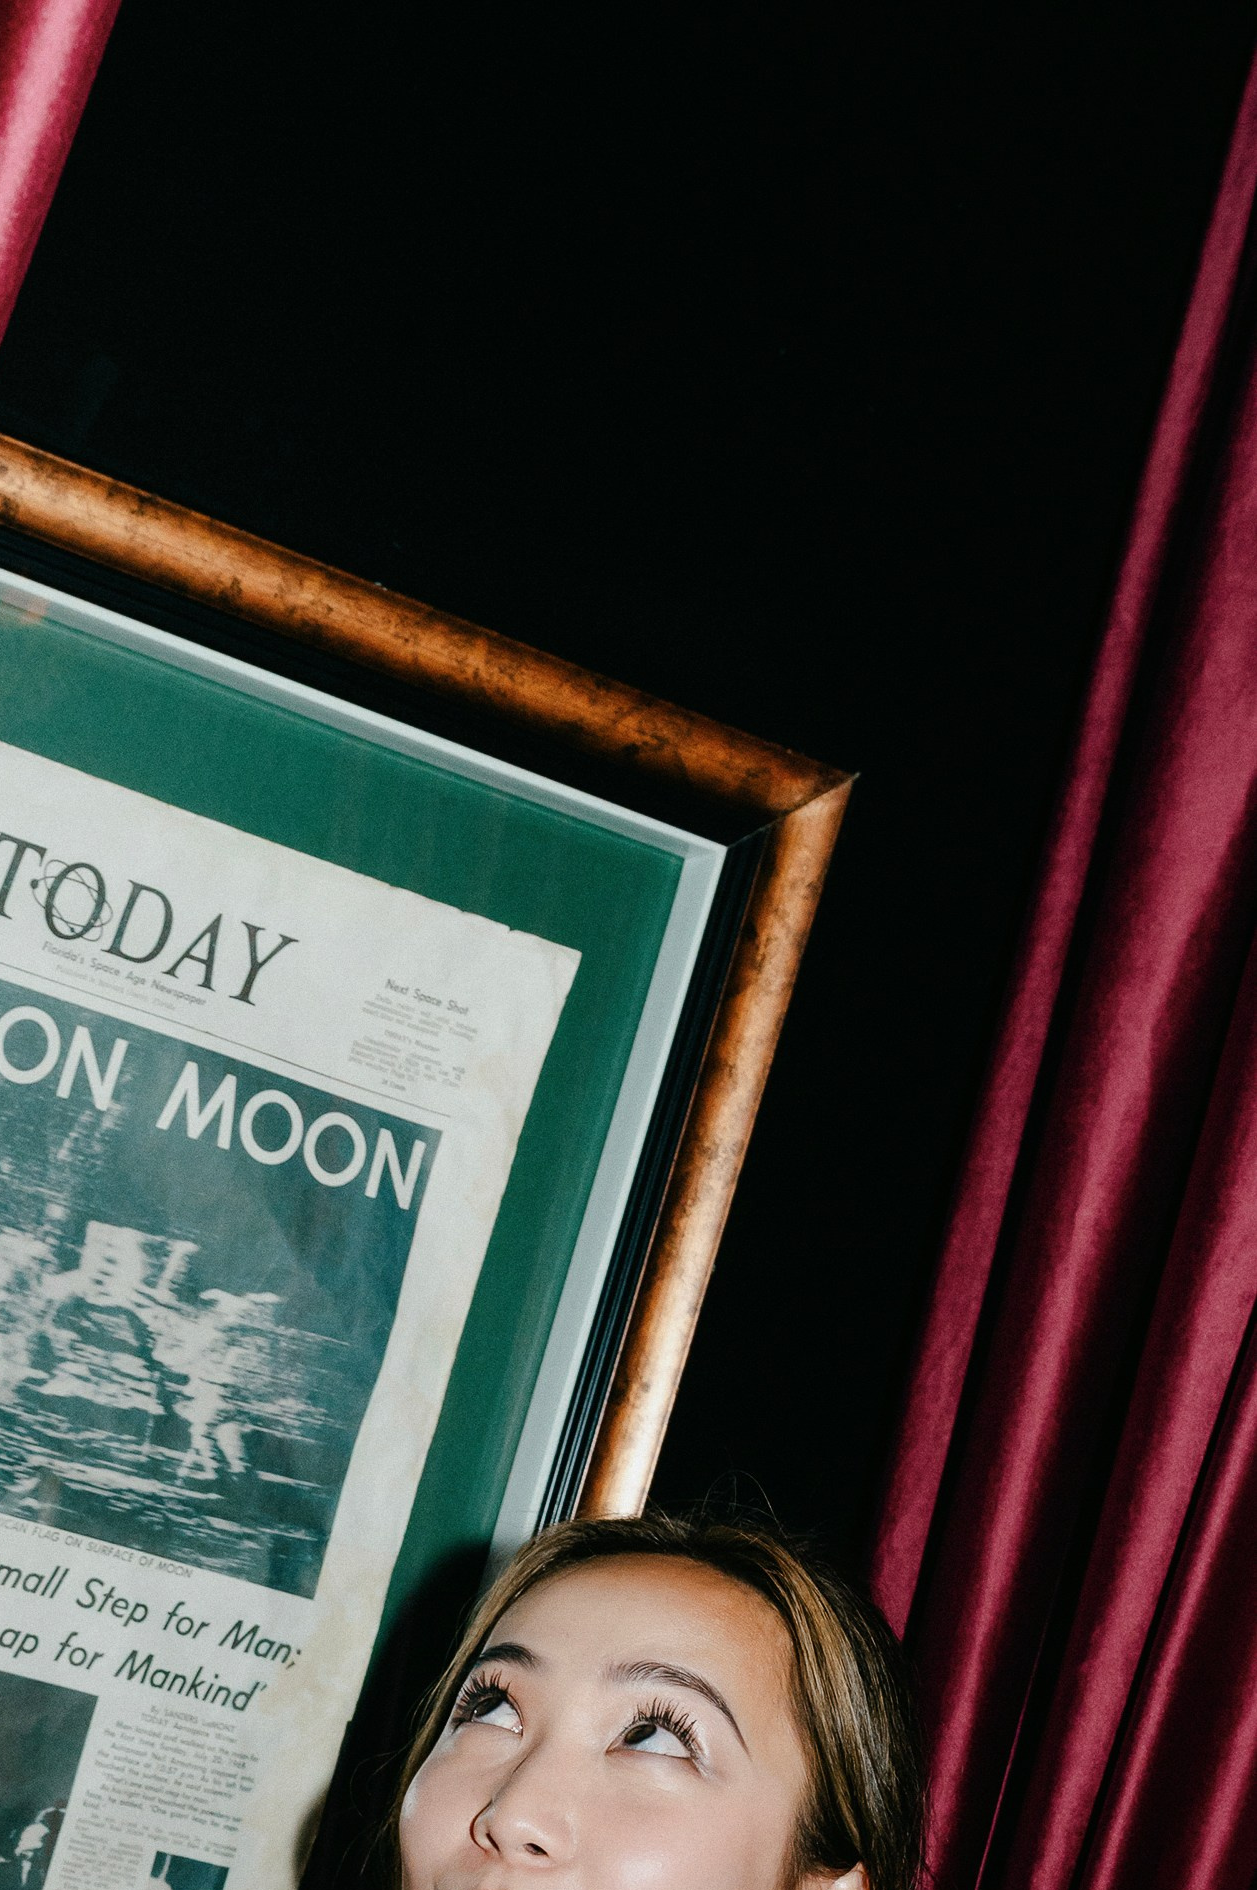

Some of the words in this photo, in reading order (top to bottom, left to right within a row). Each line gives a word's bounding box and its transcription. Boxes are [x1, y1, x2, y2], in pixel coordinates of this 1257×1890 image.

[41, 939, 85, 965] Florida's
[89, 956, 121, 977] Space
[124, 970, 147, 986] Age
[150, 978, 207, 1006] Newspaper
[412, 987, 443, 1007] Space
[154, 1060, 427, 1210] MOON
[31, 1525, 61, 1543] FLAG
[63, 1534, 83, 1549] ON
[85, 1540, 135, 1563] SURFACE
[155, 1560, 193, 1578] MOON
[53, 1630, 105, 1670] for
[75, 1577, 149, 1627] Step
[161, 1600, 211, 1639] for
[217, 1619, 302, 1669] Man;
